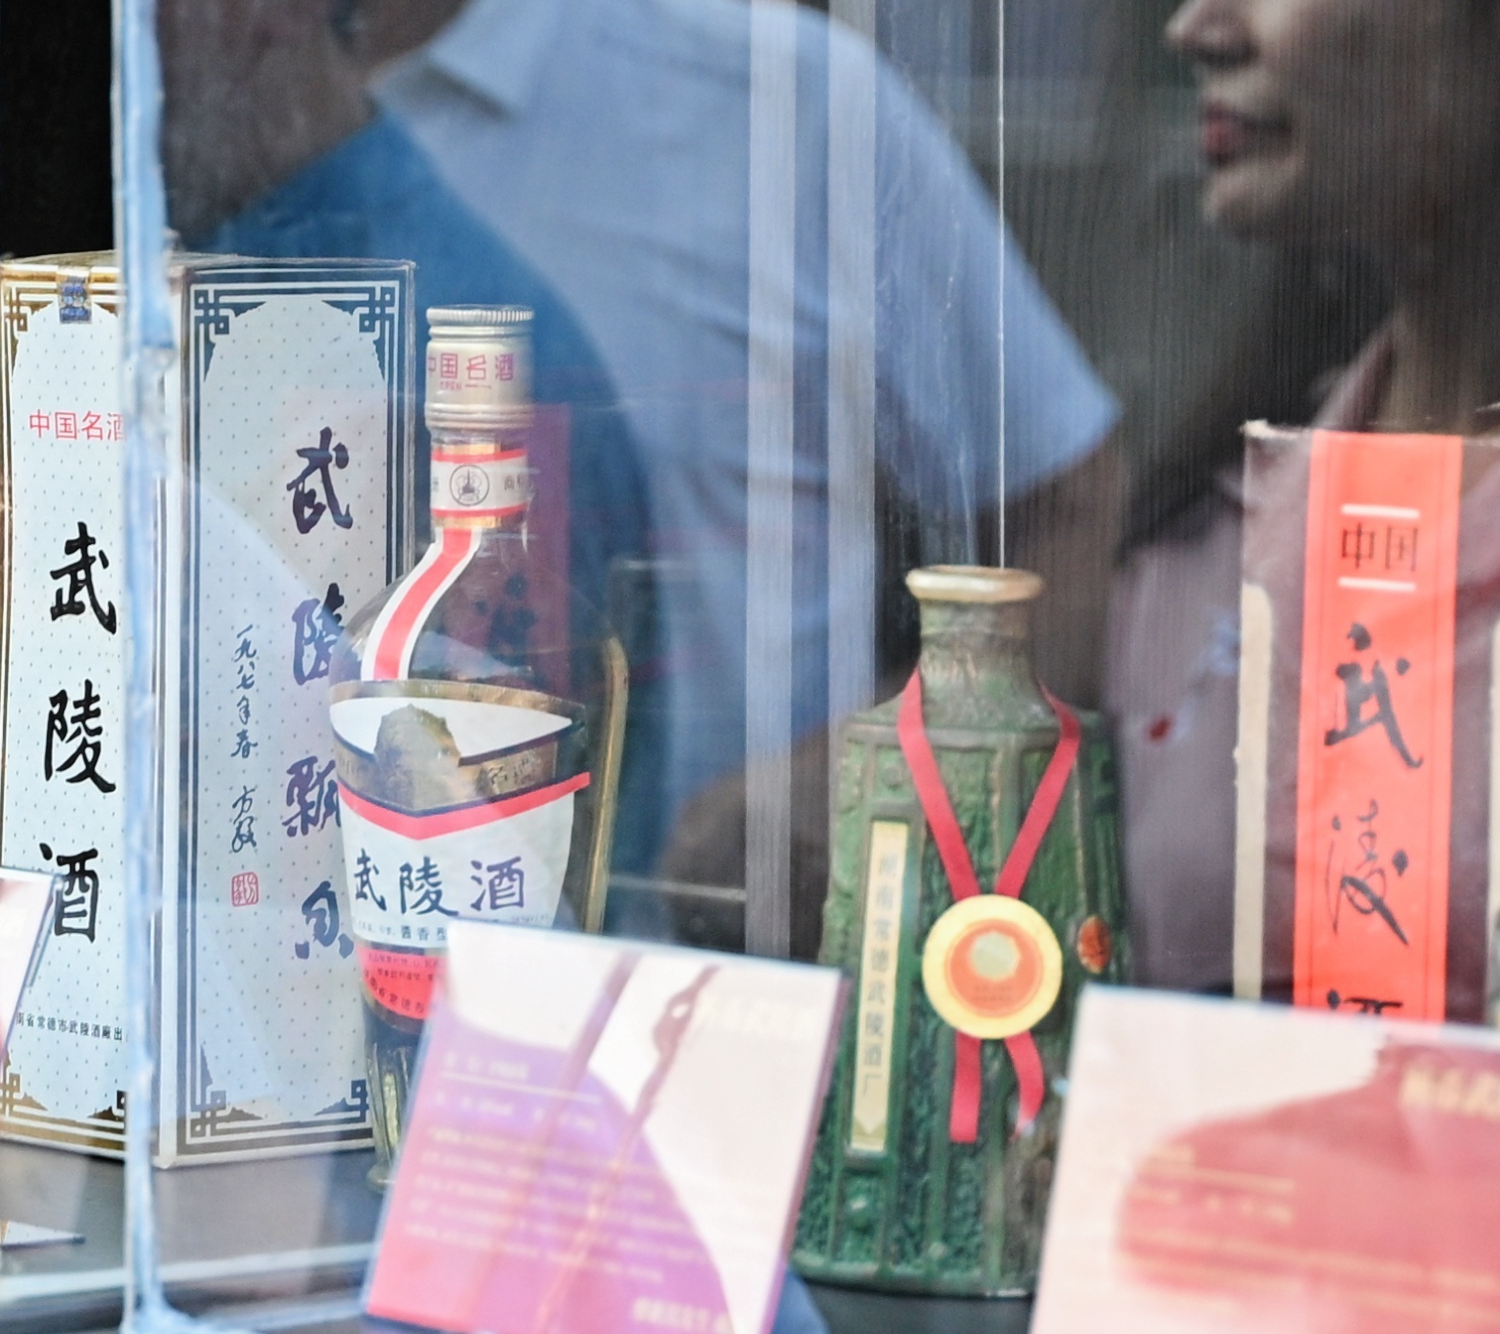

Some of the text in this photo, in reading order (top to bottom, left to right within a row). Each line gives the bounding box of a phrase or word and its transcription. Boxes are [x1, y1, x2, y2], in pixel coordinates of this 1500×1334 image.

[1341, 522, 1419, 572] 中国
[40, 521, 118, 944] 武陵酒
[1322, 622, 1425, 1019] 武陵
[353, 847, 525, 917] 武陵酒
[16, 1011, 129, 1043] 南省常德市武陵酒廠出
